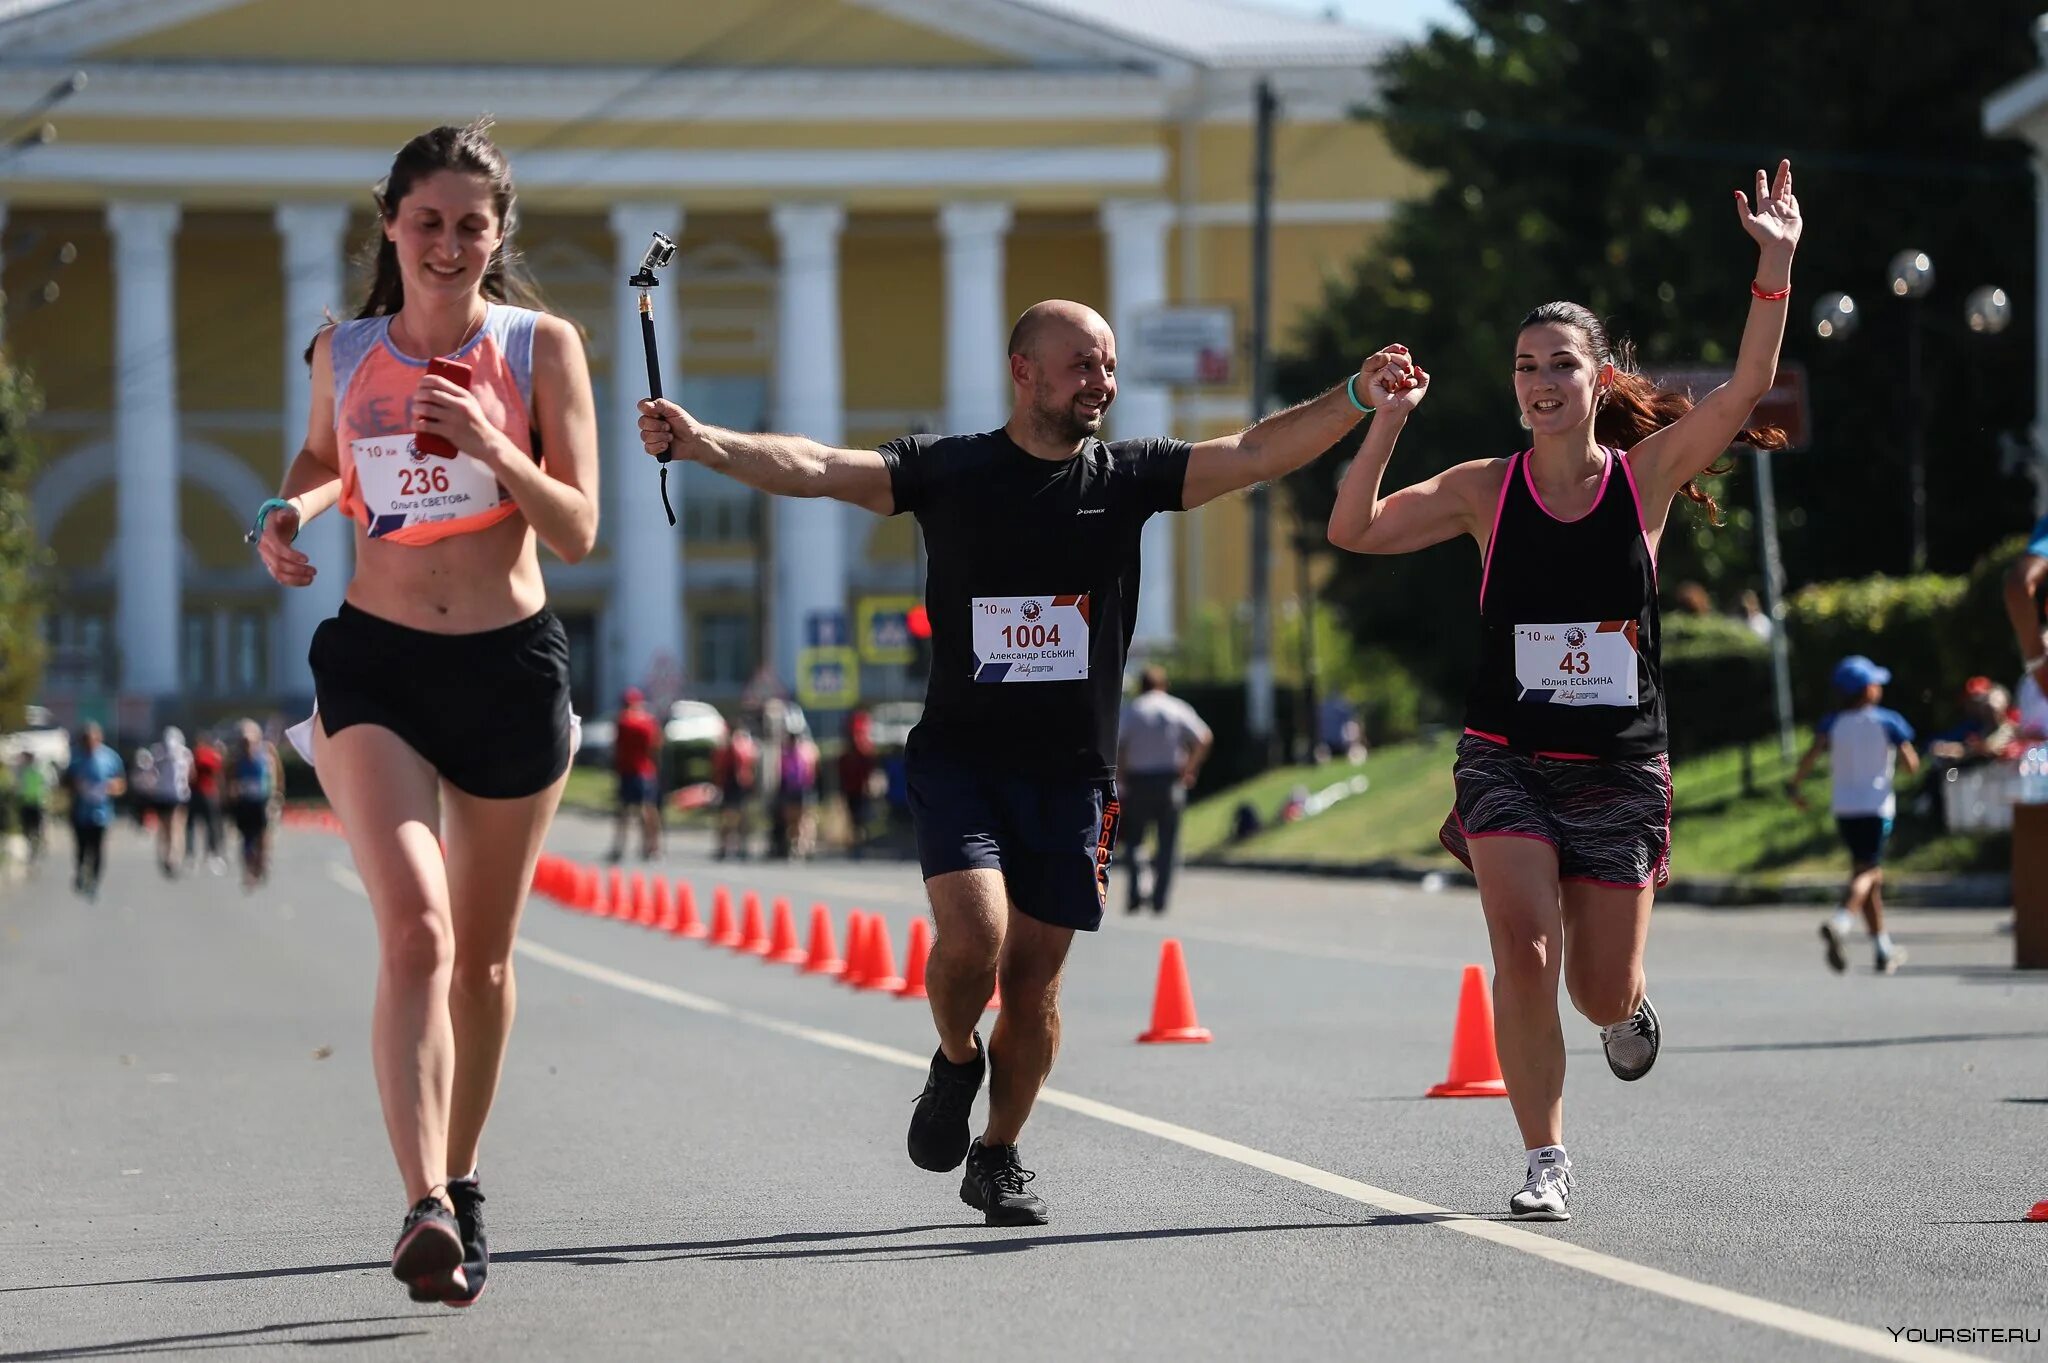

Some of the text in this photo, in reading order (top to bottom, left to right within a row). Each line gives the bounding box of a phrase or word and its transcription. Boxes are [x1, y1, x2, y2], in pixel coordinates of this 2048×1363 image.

[366, 446, 382, 459] 10
[398, 466, 449, 496] 236
[391, 493, 471, 511] Ольга СВЕТОВА
[984, 604, 997, 615] 10
[1001, 624, 1061, 649] 1004
[1527, 631, 1541, 642] 10
[989, 650, 1075, 661] Александр ЕСЬКИН
[1559, 651, 1591, 675] 43
[1541, 676, 1613, 686] Юлия ЕСЬКИНА
[1540, 1150, 1553, 1158] NIKE
